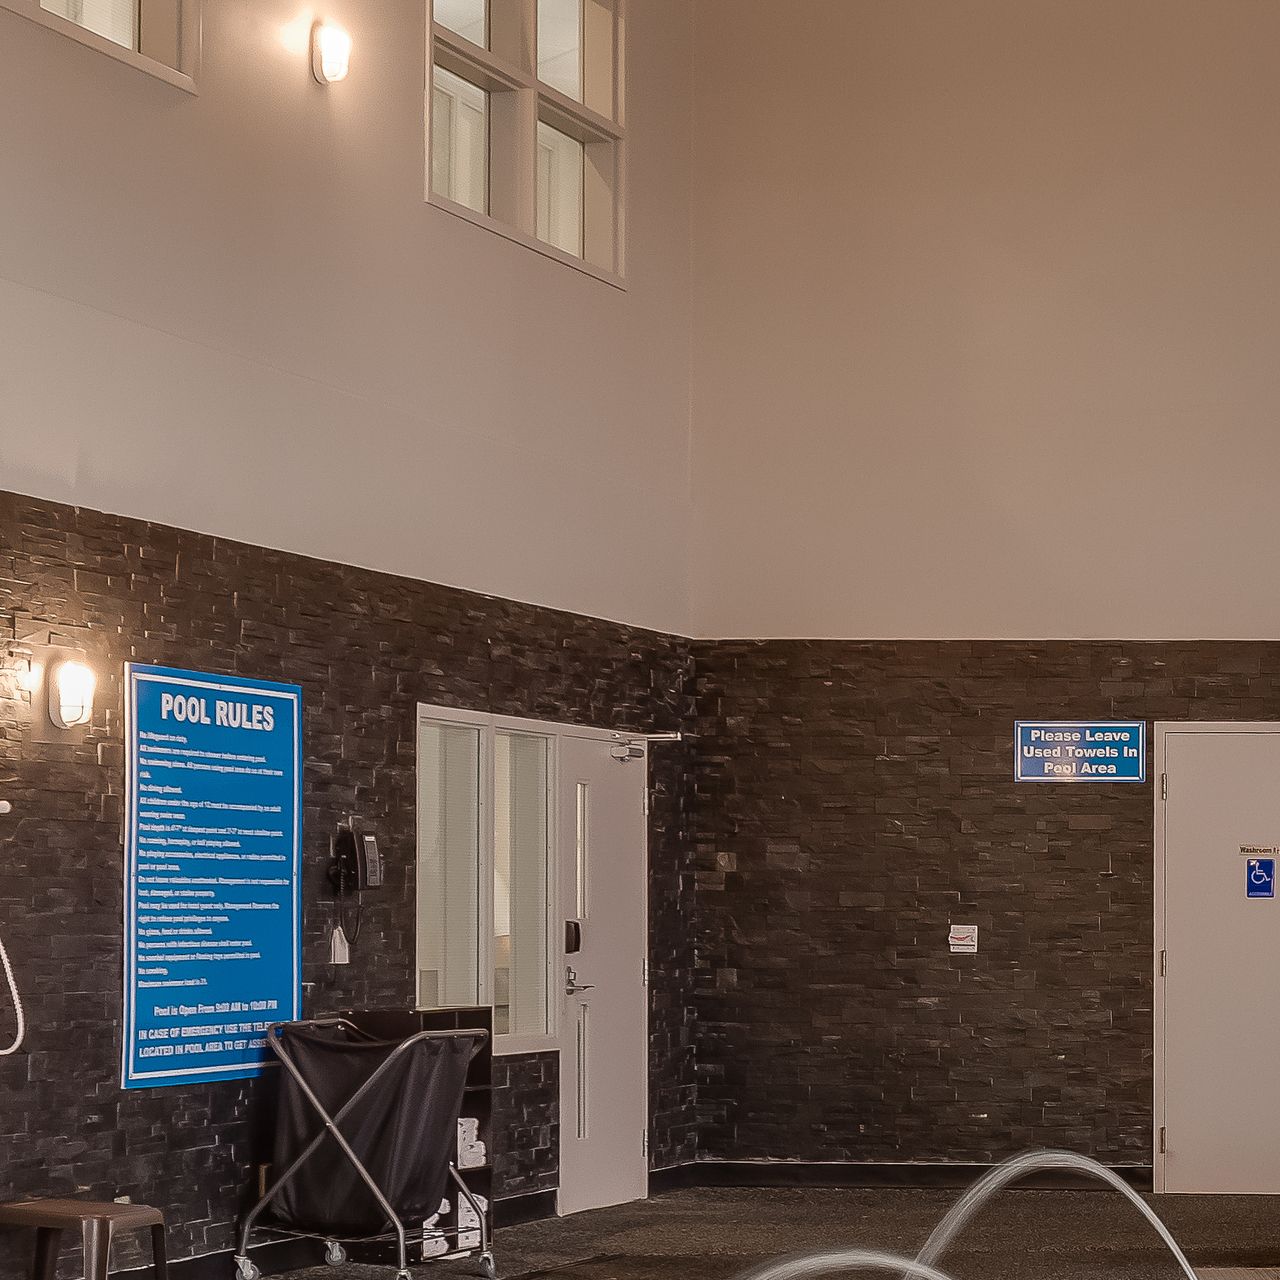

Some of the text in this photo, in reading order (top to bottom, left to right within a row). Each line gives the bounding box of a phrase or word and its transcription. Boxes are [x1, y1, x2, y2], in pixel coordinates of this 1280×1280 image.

[161, 692, 275, 731] POOL RULES
[1031, 729, 1130, 741] Please Leave
[1023, 746, 1138, 757] Used Towels In
[1044, 762, 1117, 774] Pool Area
[148, 1028, 169, 1039] CASE
[170, 1028, 180, 1038] OF
[139, 1045, 174, 1058] LOCATED
